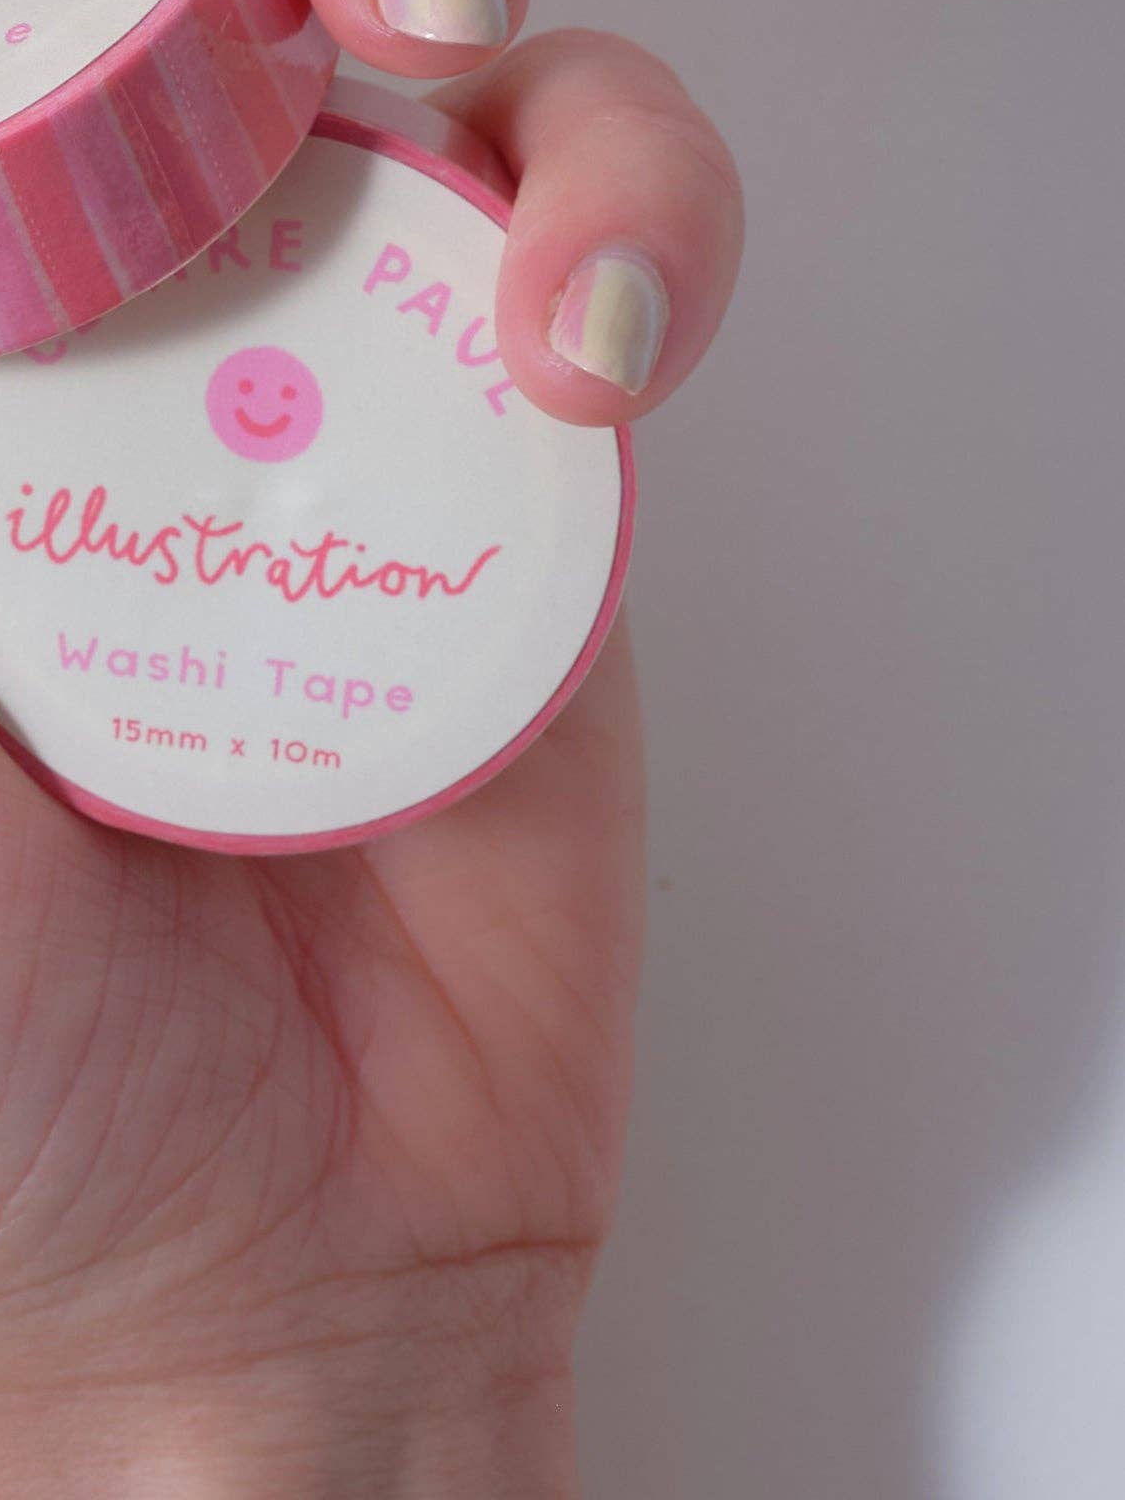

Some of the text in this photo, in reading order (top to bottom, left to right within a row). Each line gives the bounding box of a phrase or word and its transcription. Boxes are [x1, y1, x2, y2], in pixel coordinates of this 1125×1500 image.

[363, 243, 517, 417] PAUL
[5, 482, 500, 604] illustration
[57, 632, 414, 718] Washi Tape
[112, 715, 343, 769] 15mm x 10m
